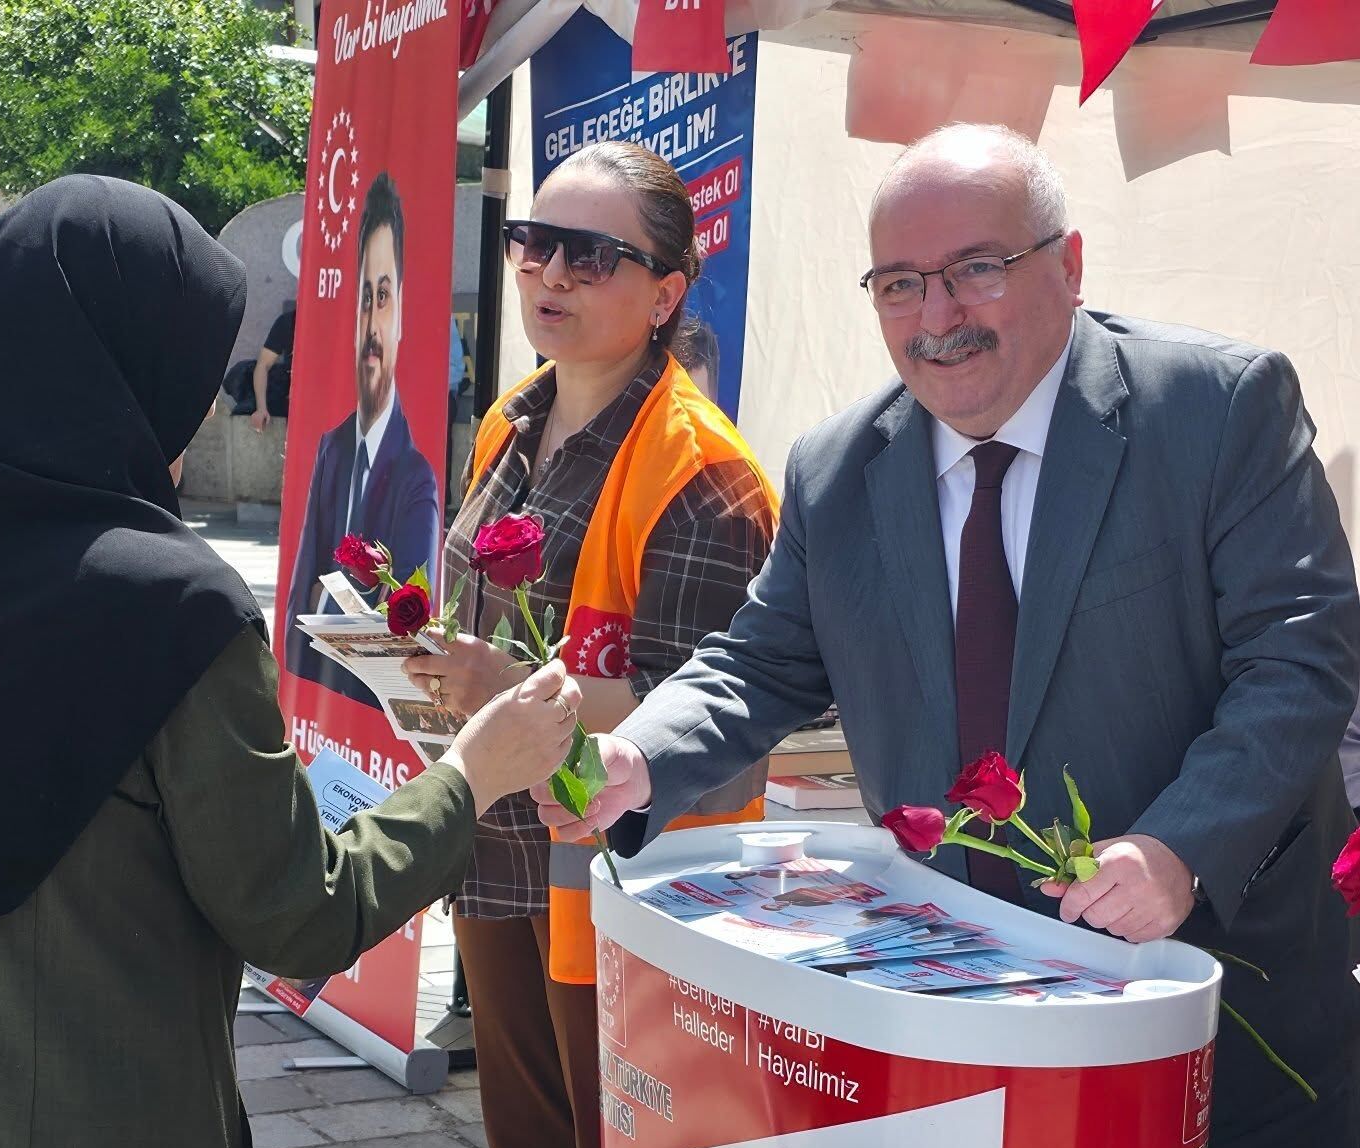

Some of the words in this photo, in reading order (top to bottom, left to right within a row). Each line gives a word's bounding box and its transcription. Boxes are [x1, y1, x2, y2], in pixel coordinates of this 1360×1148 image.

[333, 14, 360, 65] Var
[361, 1, 379, 51] bi
[545, 96, 645, 161] GELECEĞE
[318, 268, 342, 299] BTP
[672, 1001, 735, 1055] Halleder
[758, 1042, 860, 1104] Hayalimiz
